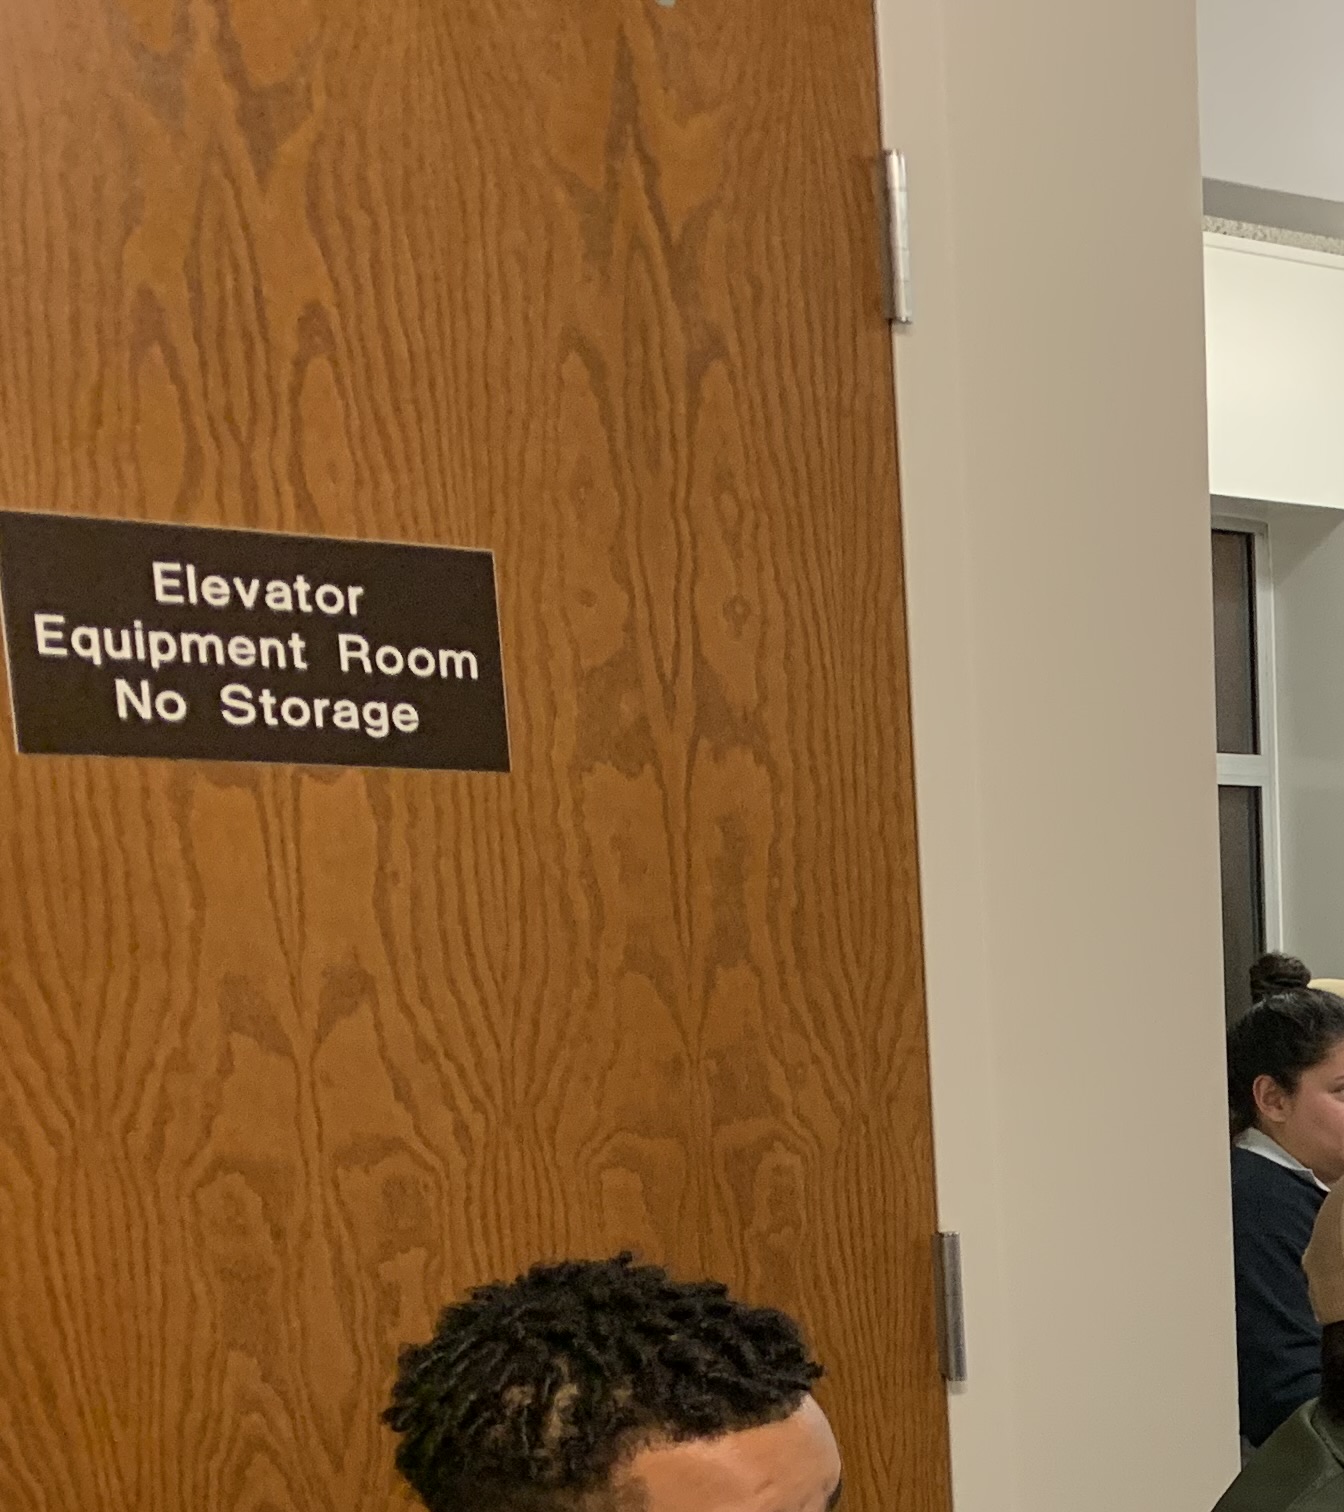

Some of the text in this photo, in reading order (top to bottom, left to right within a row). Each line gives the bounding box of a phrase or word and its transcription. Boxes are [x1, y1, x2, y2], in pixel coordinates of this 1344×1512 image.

[153, 561, 363, 616] Elevator
[34, 613, 478, 680] Equipment Room
[115, 679, 420, 738] No Storage
